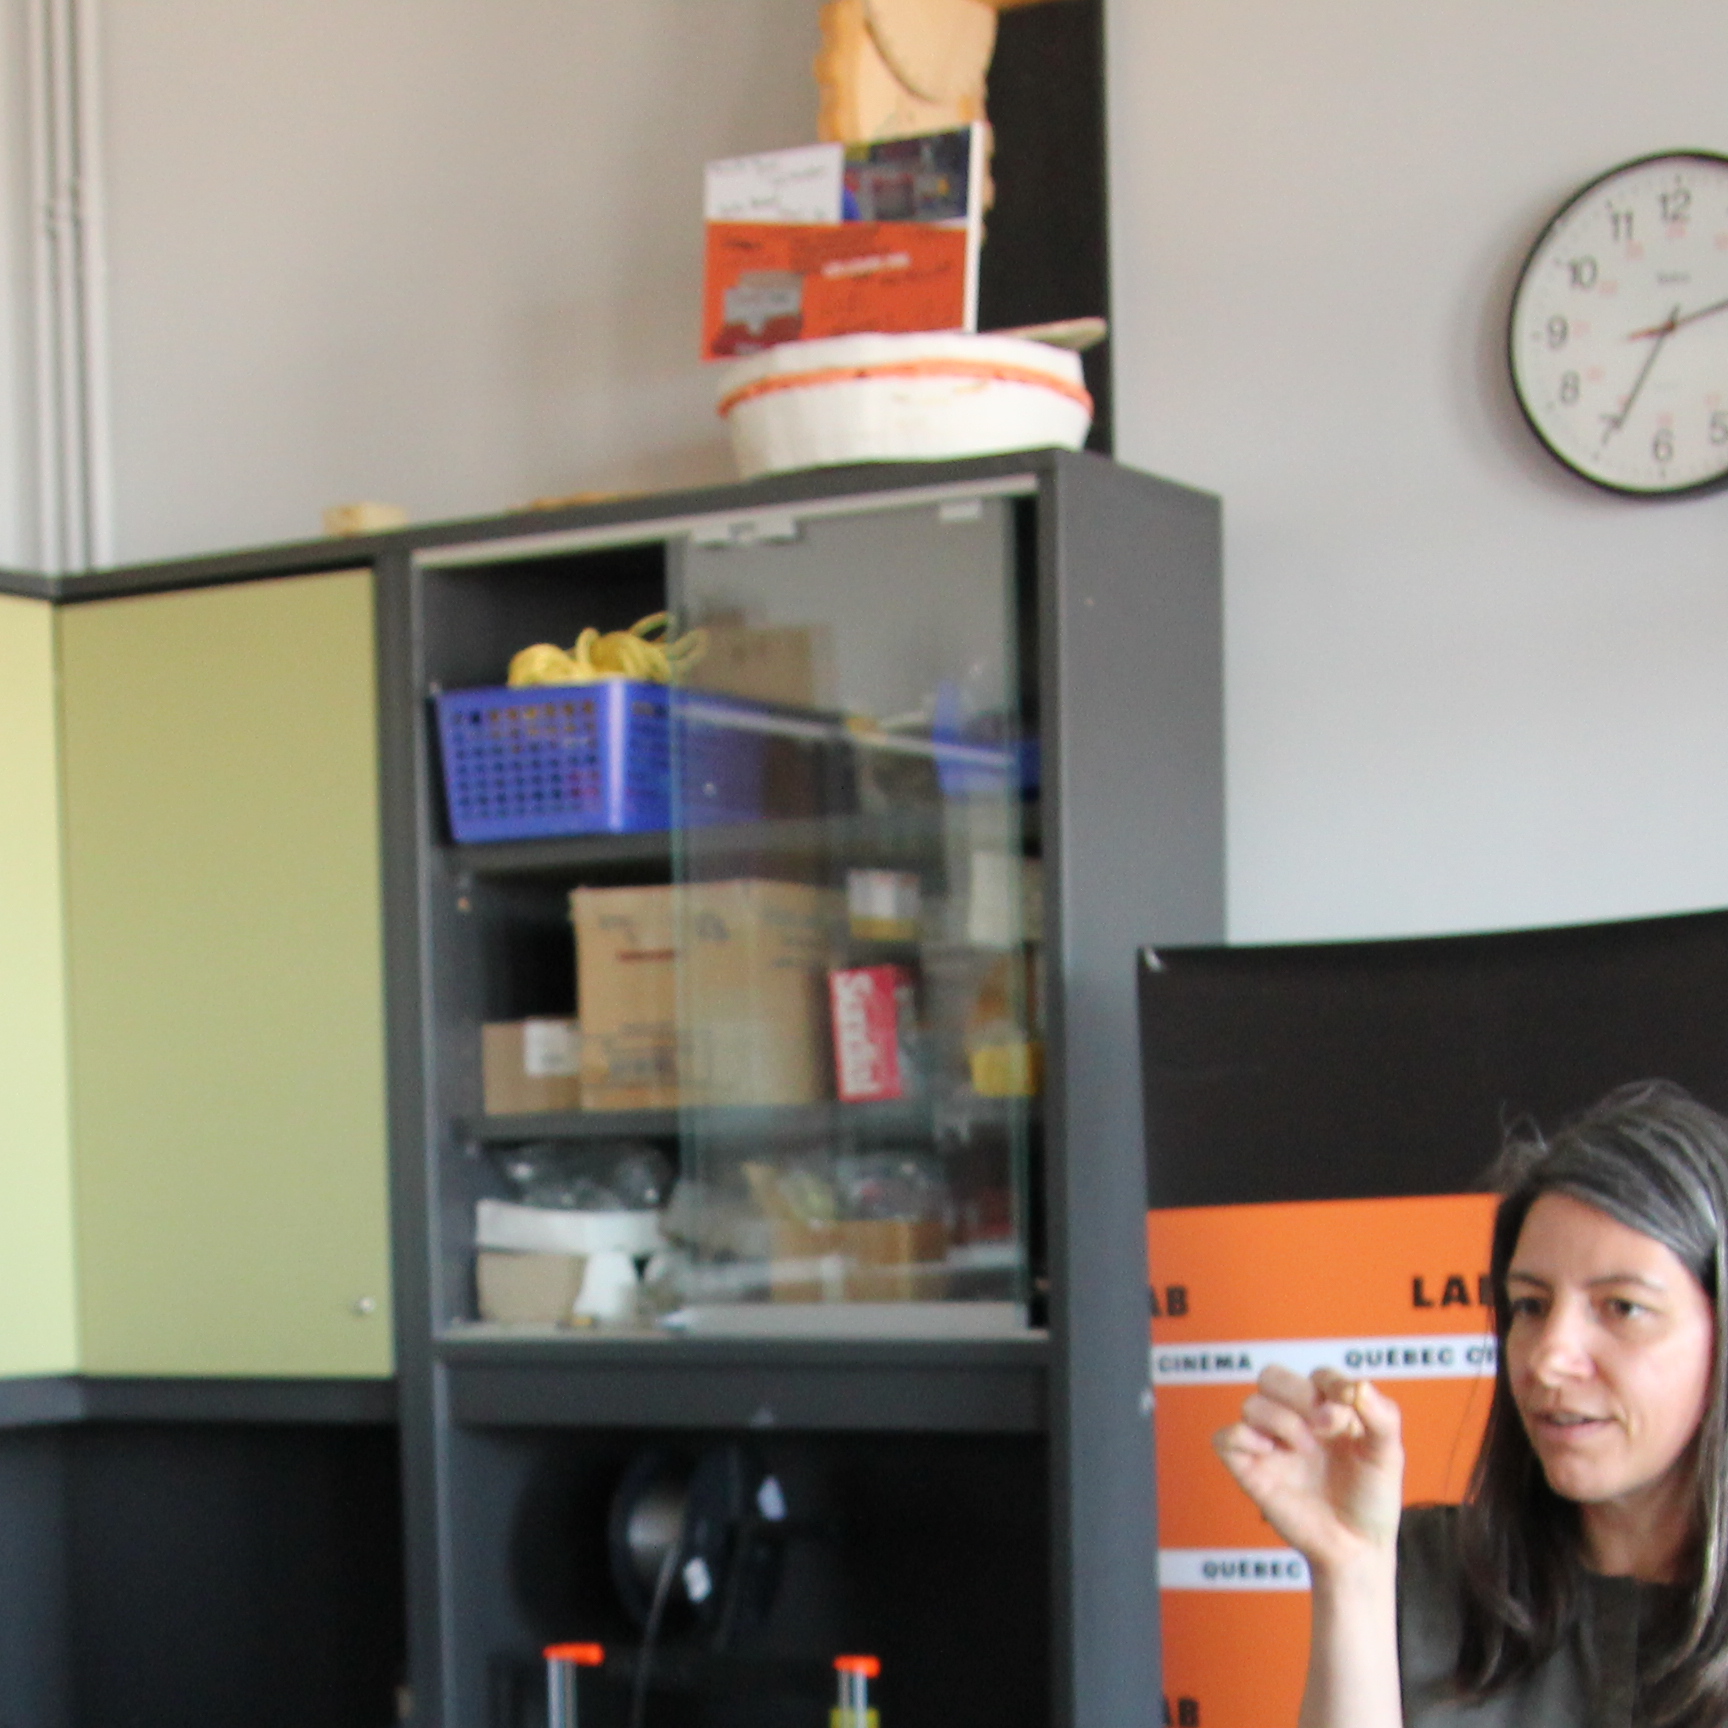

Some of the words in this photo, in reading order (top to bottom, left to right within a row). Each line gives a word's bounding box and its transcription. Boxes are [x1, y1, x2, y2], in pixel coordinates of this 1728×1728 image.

[1658, 187, 1692, 222] 12
[1610, 208, 1635, 242] 11
[1570, 255, 1598, 289] 10
[1547, 313, 1568, 350] 9
[1560, 369, 1581, 406] 8
[1652, 428, 1674, 462] 6
